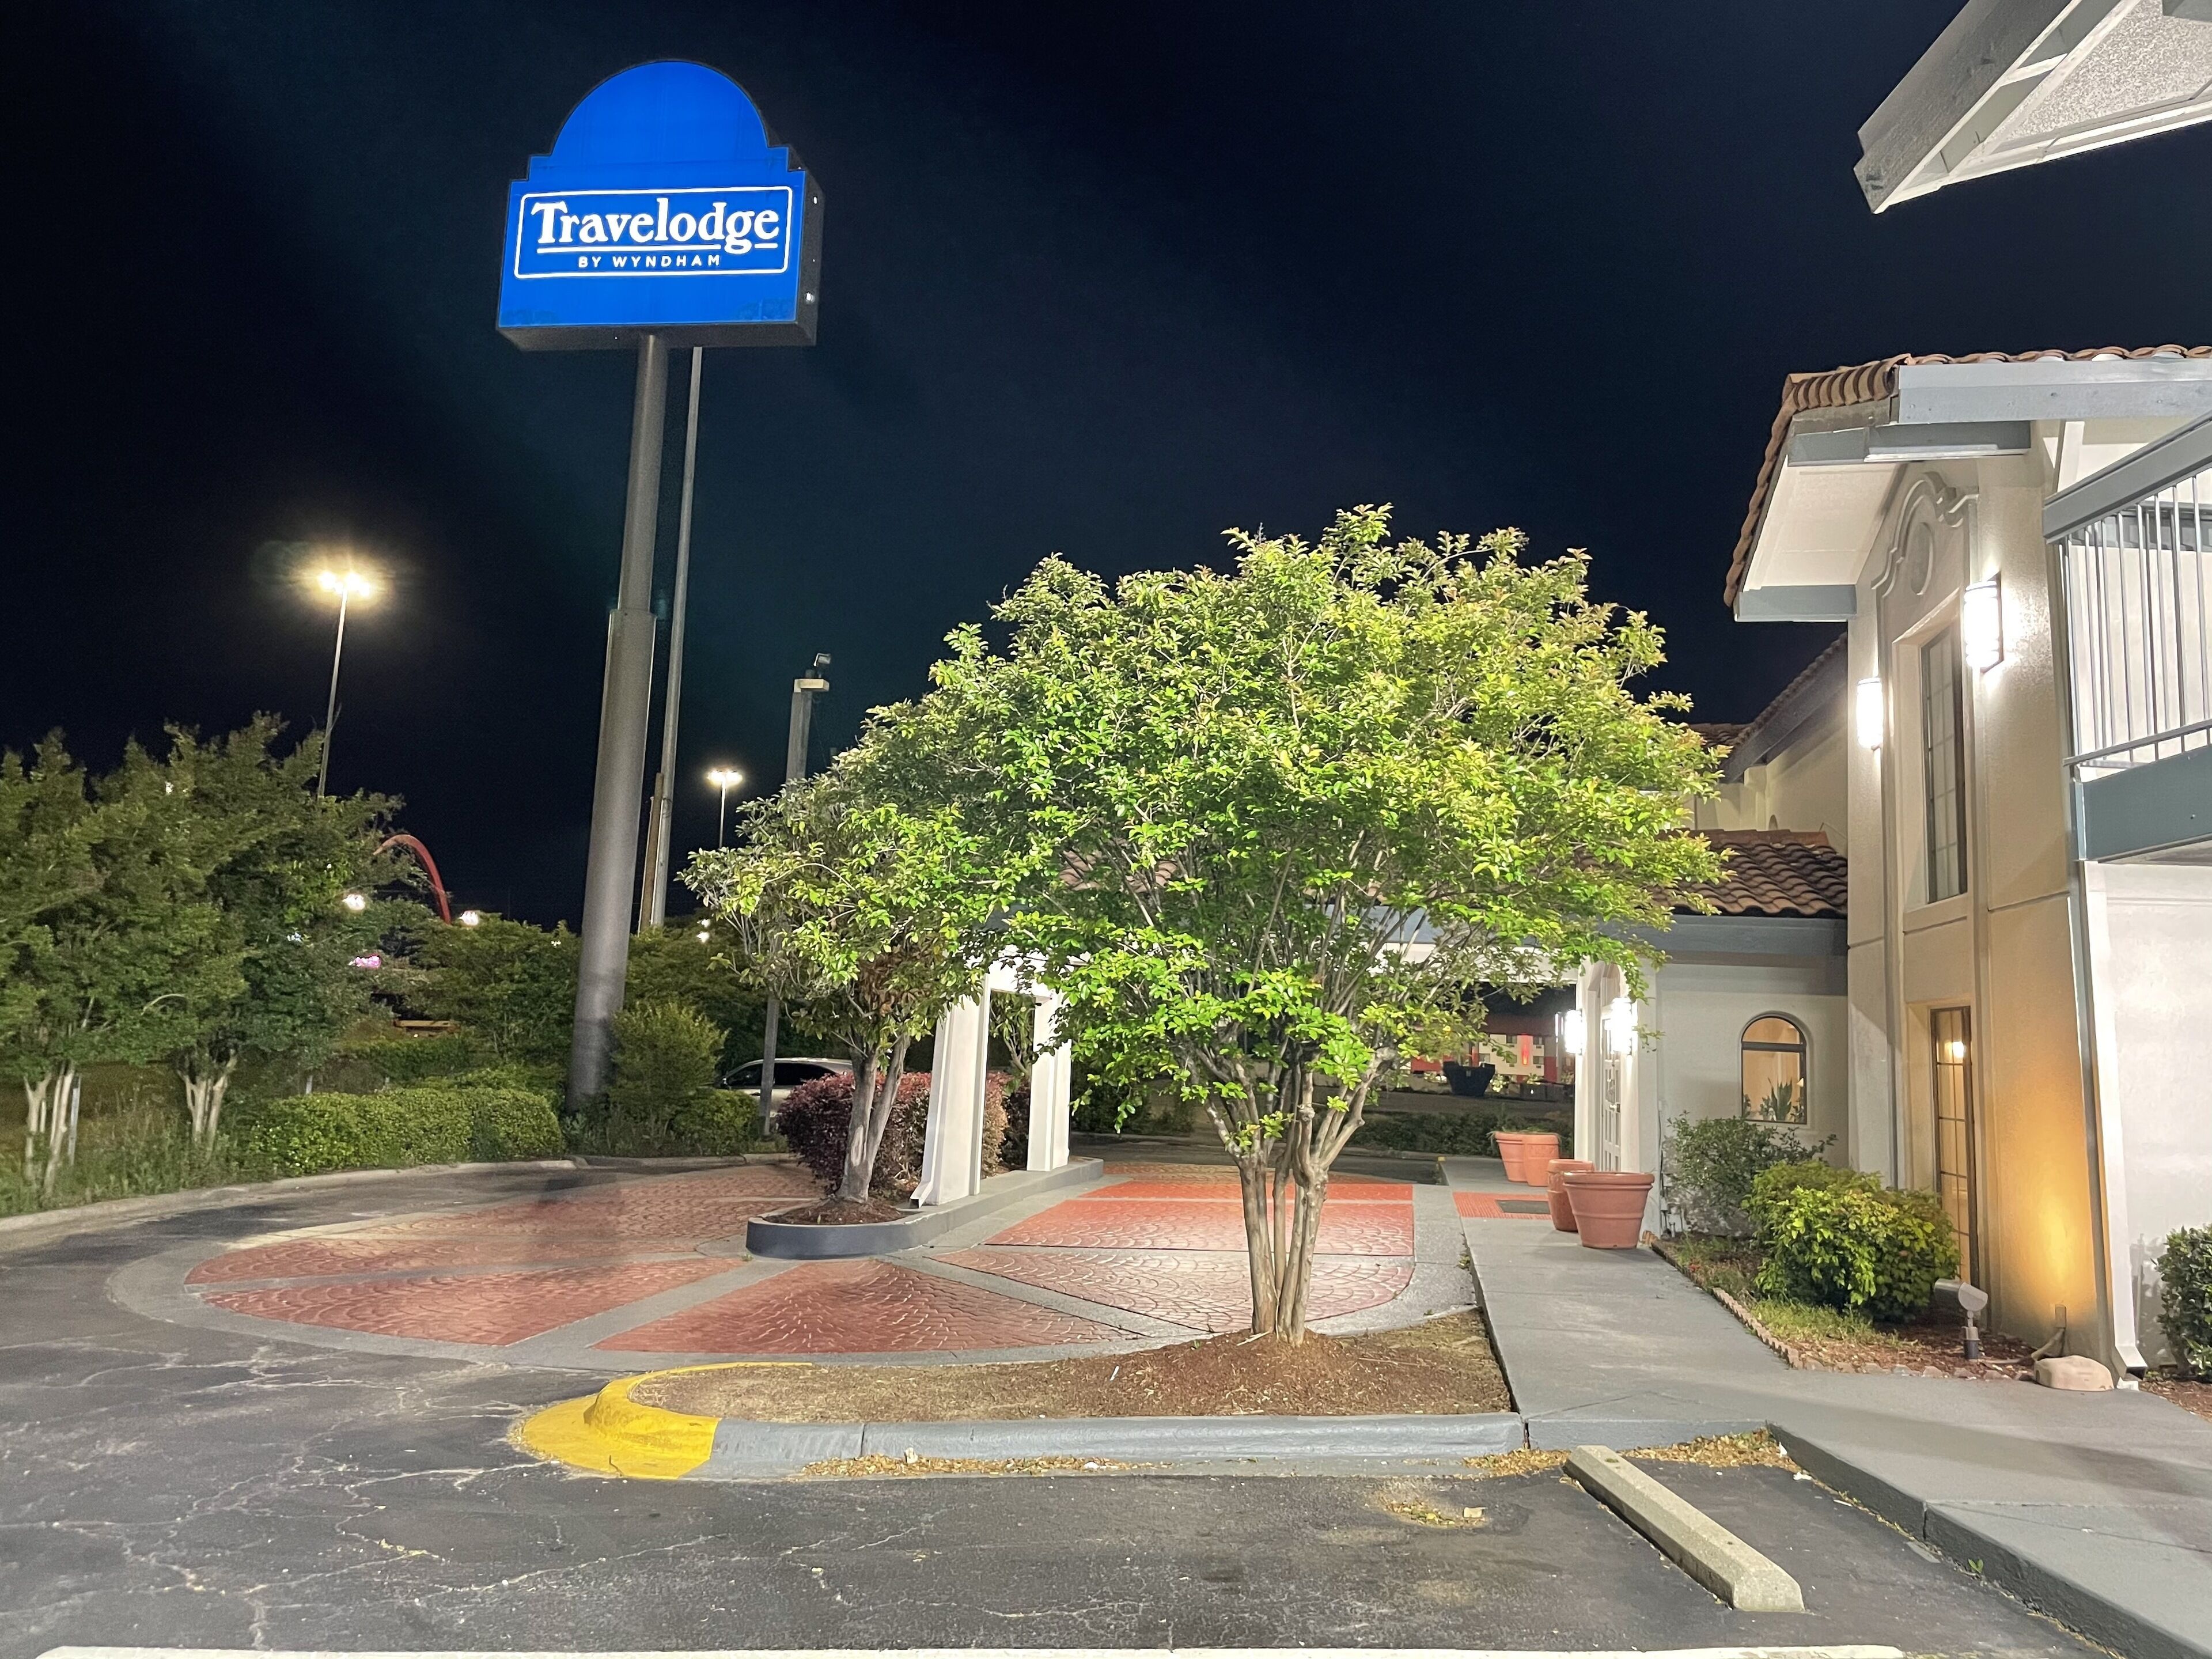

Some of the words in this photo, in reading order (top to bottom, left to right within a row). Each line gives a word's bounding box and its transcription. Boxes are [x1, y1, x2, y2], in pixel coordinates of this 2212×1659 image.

[531, 198, 779, 255] Travelodge
[578, 256, 601, 268] BY
[612, 255, 720, 268] WYNDHAM
